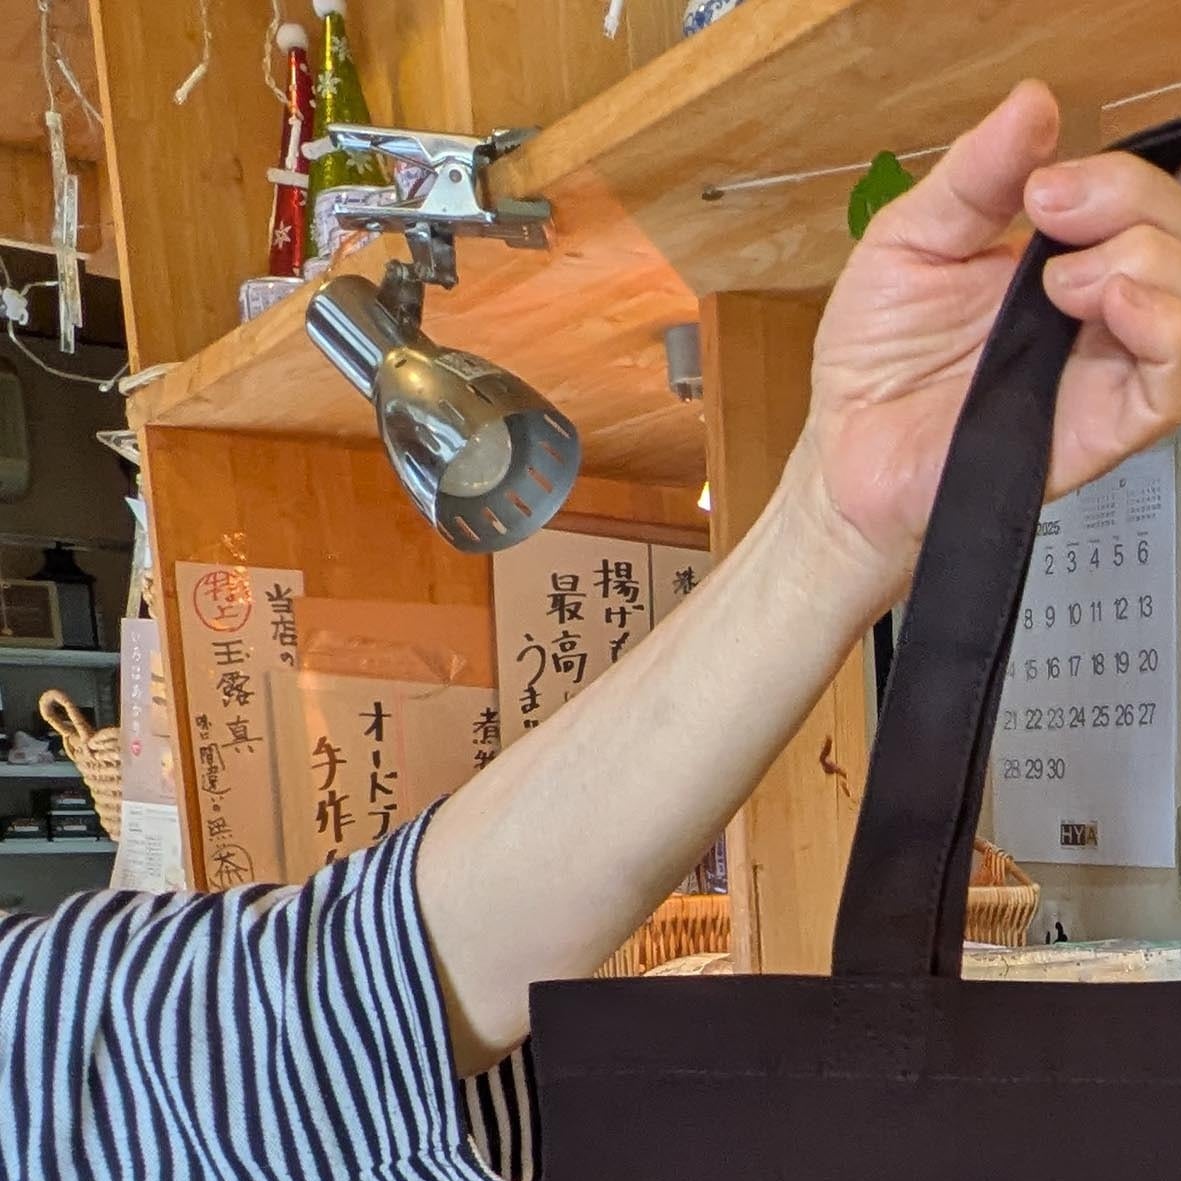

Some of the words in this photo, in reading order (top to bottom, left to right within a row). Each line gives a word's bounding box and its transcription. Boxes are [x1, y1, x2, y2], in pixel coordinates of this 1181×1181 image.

[1044, 553, 1055, 576] 2
[1064, 550, 1078, 574] 3
[1089, 547, 1100, 572] 4
[1112, 543, 1125, 568] 5
[1137, 539, 1149, 566] 6
[1023, 607, 1034, 630] 8
[1044, 605, 1056, 629] 9
[1067, 602, 1083, 628] 10
[1089, 600, 1103, 623] 11
[1113, 596, 1129, 621] 12
[1137, 594, 1153, 619] 13
[1045, 655, 1061, 681] 16
[1067, 654, 1082, 678] 17
[1090, 652, 1106, 676] 18
[1113, 650, 1130, 675] 19
[1137, 647, 1159, 674] 20
[1023, 707, 1044, 733] 22
[1046, 706, 1065, 731] 23
[1068, 705, 1086, 729] 24
[1091, 704, 1111, 728] 25
[1114, 703, 1135, 728] 26
[1137, 701, 1157, 727] 27
[1024, 755, 1044, 780] 29
[1046, 757, 1066, 780] 30
